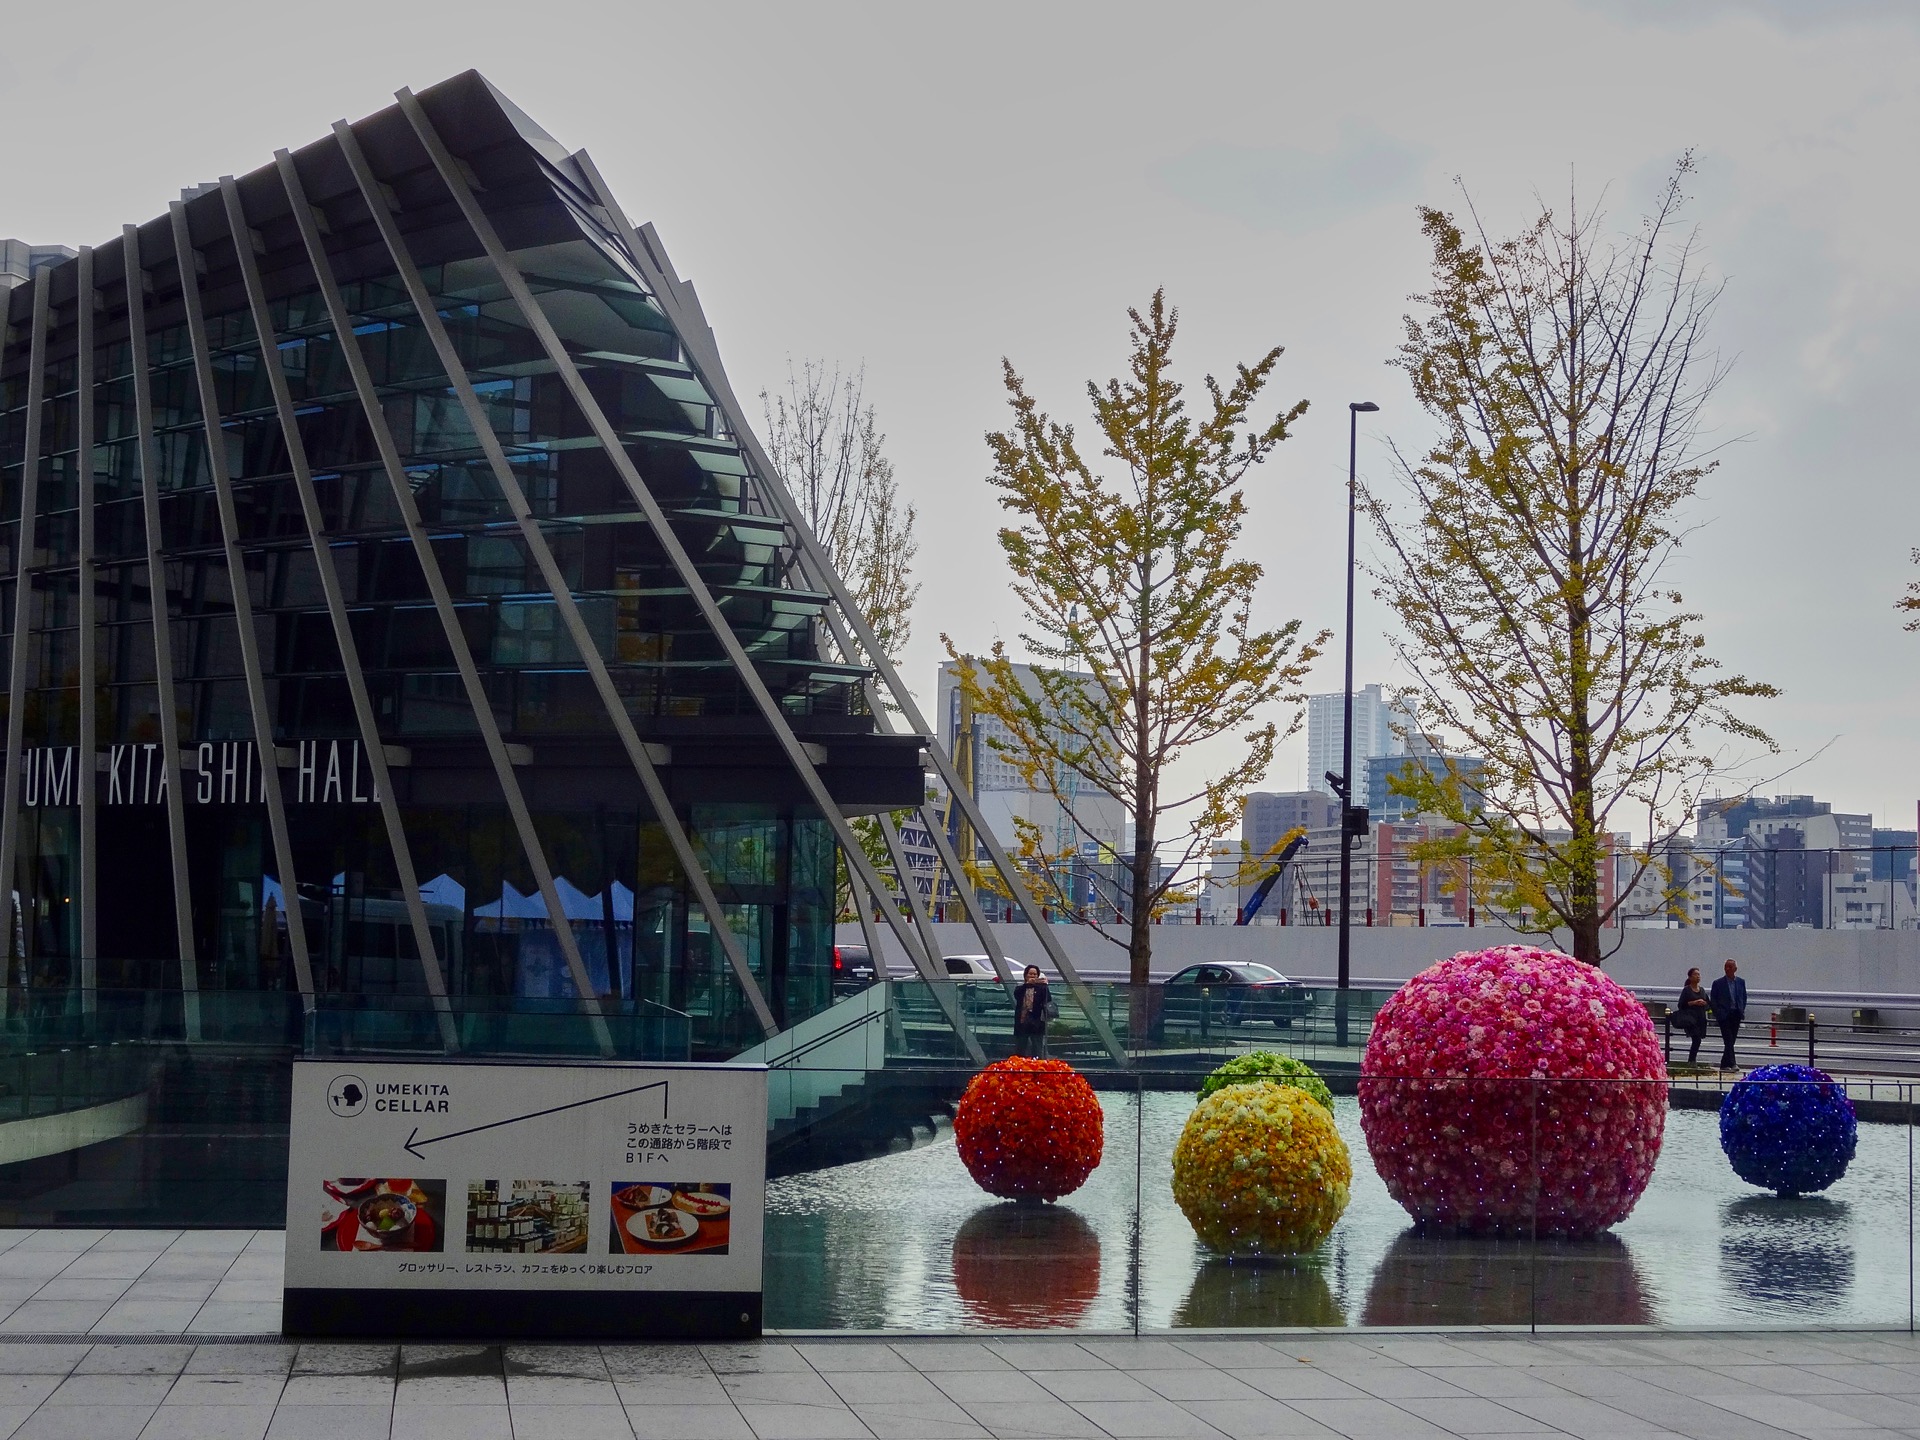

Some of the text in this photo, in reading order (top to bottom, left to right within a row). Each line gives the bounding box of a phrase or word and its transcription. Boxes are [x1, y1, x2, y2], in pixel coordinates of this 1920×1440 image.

[197, 741, 267, 804] SHI
[376, 1083, 450, 1096] UMEKITA
[375, 1098, 449, 1113] CELLAR
[627, 1122, 733, 1136] うめきたセラーへは
[626, 1137, 732, 1151] この通路から階段で
